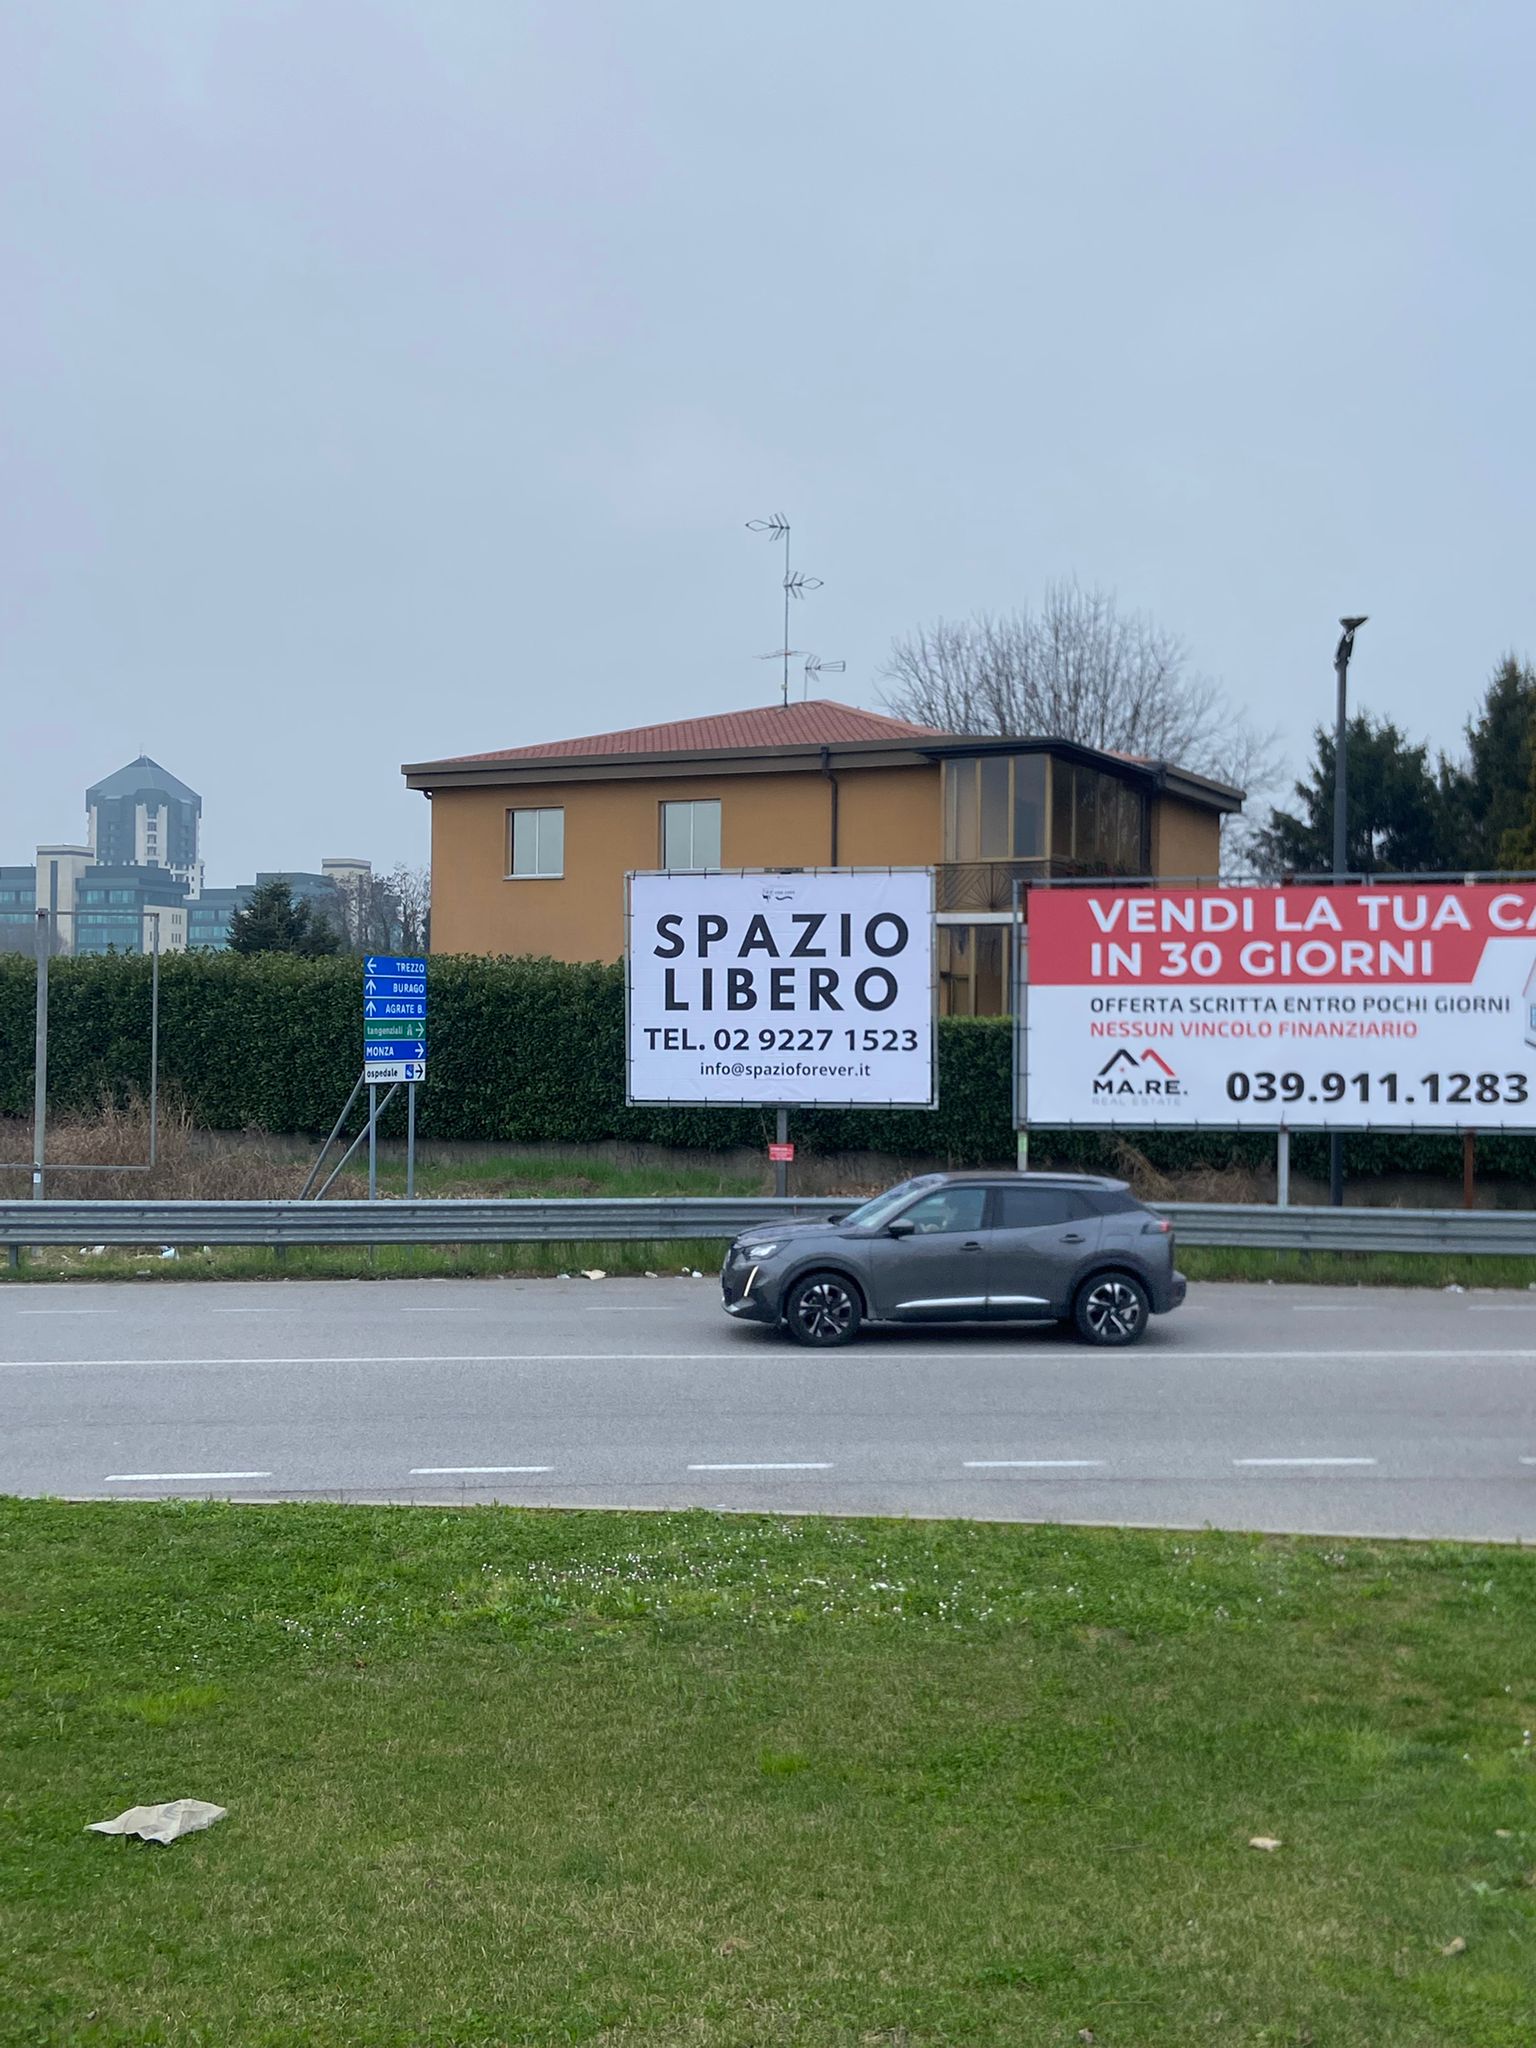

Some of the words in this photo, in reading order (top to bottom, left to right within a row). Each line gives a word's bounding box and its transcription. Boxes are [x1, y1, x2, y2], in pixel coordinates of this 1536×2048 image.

[1088, 898, 1254, 933] VENDI
[1275, 896, 1342, 932] LA
[1357, 895, 1471, 931] TUA
[1488, 893, 1536, 931] C
[653, 912, 909, 959] SPAZIO
[1091, 943, 1142, 977] IN
[1159, 941, 1223, 977] 30
[1239, 940, 1433, 976] GIORNI
[396, 962, 425, 973] TREZZO
[392, 983, 425, 993] BURAGO
[664, 966, 898, 1012] LIBERO
[385, 1003, 415, 1014] AGRATE
[1090, 997, 1183, 1014] OFFERTA
[1190, 997, 1277, 1014] SCRITTA
[1284, 996, 1356, 1014] ENTRO
[1363, 996, 1428, 1013] POCHI
[1434, 995, 1511, 1014] GIORNI
[367, 1026, 403, 1036] tangenziali
[1090, 1021, 1174, 1037] NESSUN
[1181, 1021, 1272, 1037] VINCOLO
[1279, 1020, 1419, 1038] FINANZIARIO
[643, 1028, 706, 1051] TEL.
[713, 1028, 750, 1051] 02
[758, 1029, 833, 1051] 9227
[844, 1029, 919, 1051] 1523
[366, 1046, 394, 1057] MONZA
[366, 1068, 398, 1079] ospedale
[699, 1062, 872, 1079] info@spazioforever.it
[1093, 1080, 1189, 1096] MA.RE.
[1226, 1072, 1530, 1103] 039.911.1283
